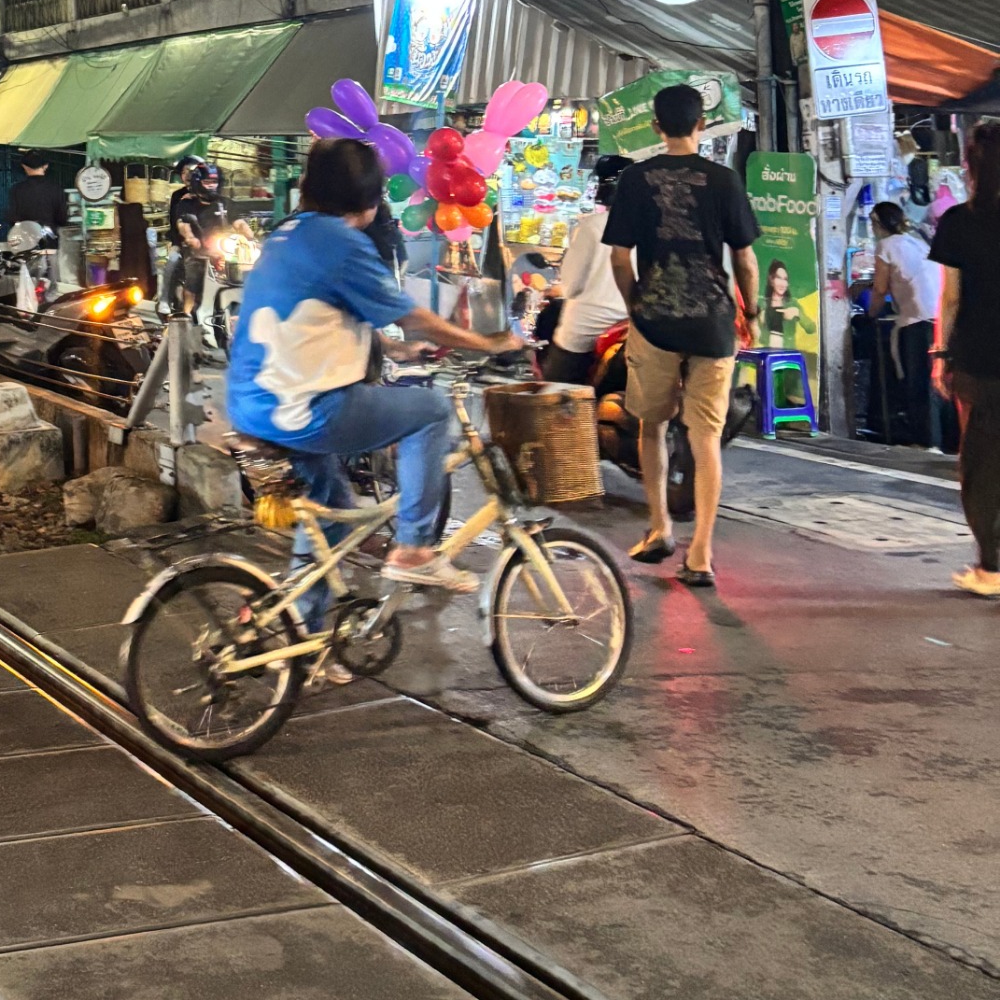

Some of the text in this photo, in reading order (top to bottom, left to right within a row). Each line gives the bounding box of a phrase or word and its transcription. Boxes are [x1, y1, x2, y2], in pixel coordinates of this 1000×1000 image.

[820, 90, 884, 113] ทางเดียว
[747, 191, 821, 217] rabFood
